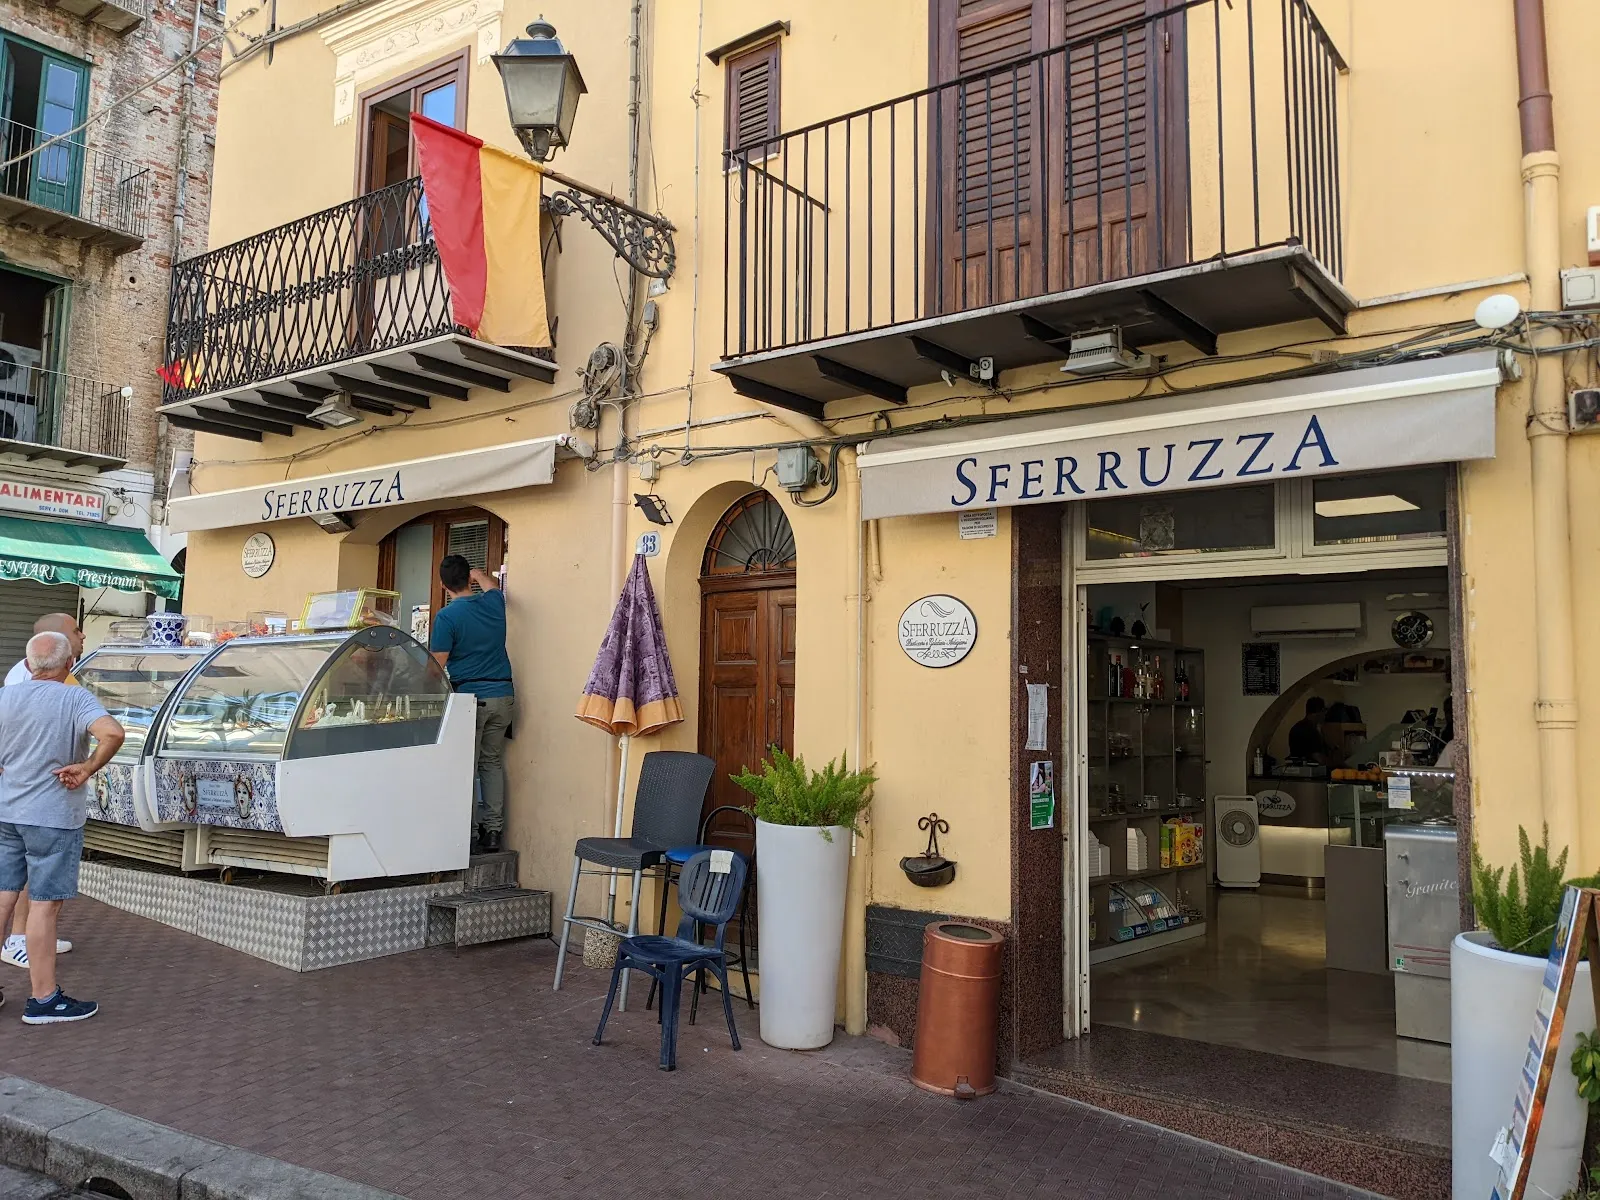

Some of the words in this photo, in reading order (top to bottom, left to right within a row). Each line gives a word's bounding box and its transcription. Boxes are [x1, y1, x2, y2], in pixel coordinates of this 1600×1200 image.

[951, 414, 1340, 507] SFERRUZZA
[0, 483, 101, 509] ALIMENTARI
[261, 470, 405, 520] SFERRUZZA
[77, 568, 138, 587] Prestianni
[902, 616, 971, 638] SFERRUZZA
